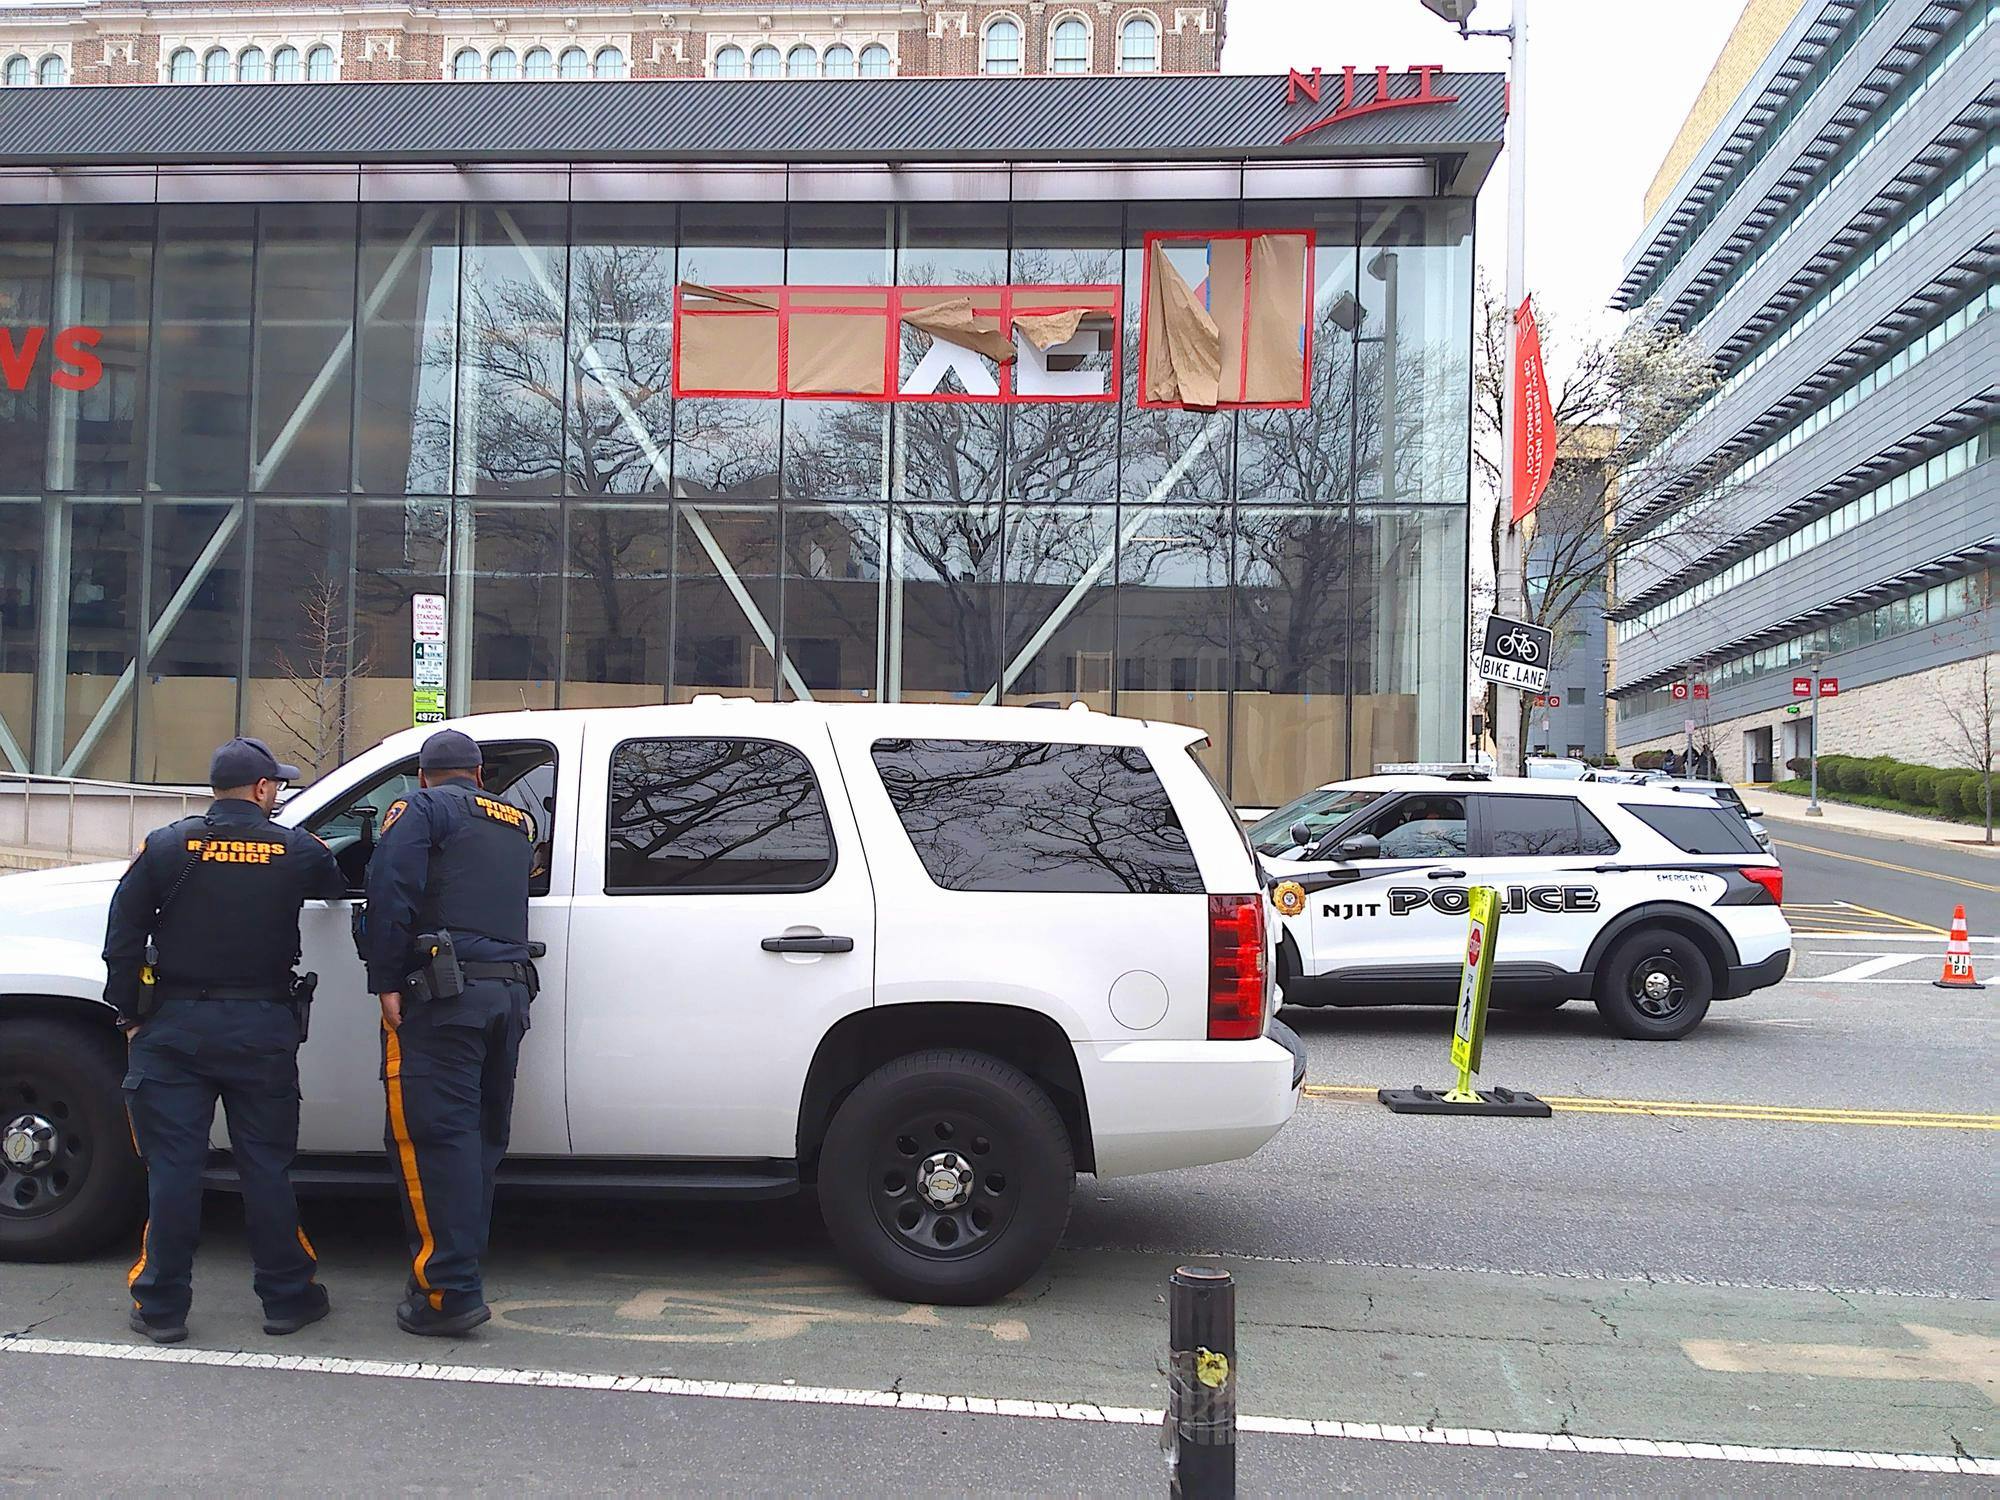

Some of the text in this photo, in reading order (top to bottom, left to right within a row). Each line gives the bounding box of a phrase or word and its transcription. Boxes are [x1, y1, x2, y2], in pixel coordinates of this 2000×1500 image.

[1287, 65, 1443, 114] NJIT
[1523, 359, 1535, 475] OF TECHNOLOGY
[1526, 355, 1543, 506] NEW JERSEY INSTITUTE
[416, 603, 442, 611] PARKING
[416, 613, 443, 621] STANDING
[1483, 659, 1545, 687] BIKE LANE
[416, 712, 444, 722] 49722
[474, 796, 524, 821] RUTGERS
[485, 807, 521, 827] POLICE
[186, 840, 286, 856] RUTGERS
[201, 851, 272, 864] POLICE
[1657, 874, 1704, 882] EMERGENCY
[1690, 884, 1708, 892] 911
[1323, 903, 1381, 921] NJIT
[1387, 885, 1600, 916] POICE
[1954, 965, 1967, 974] PD
